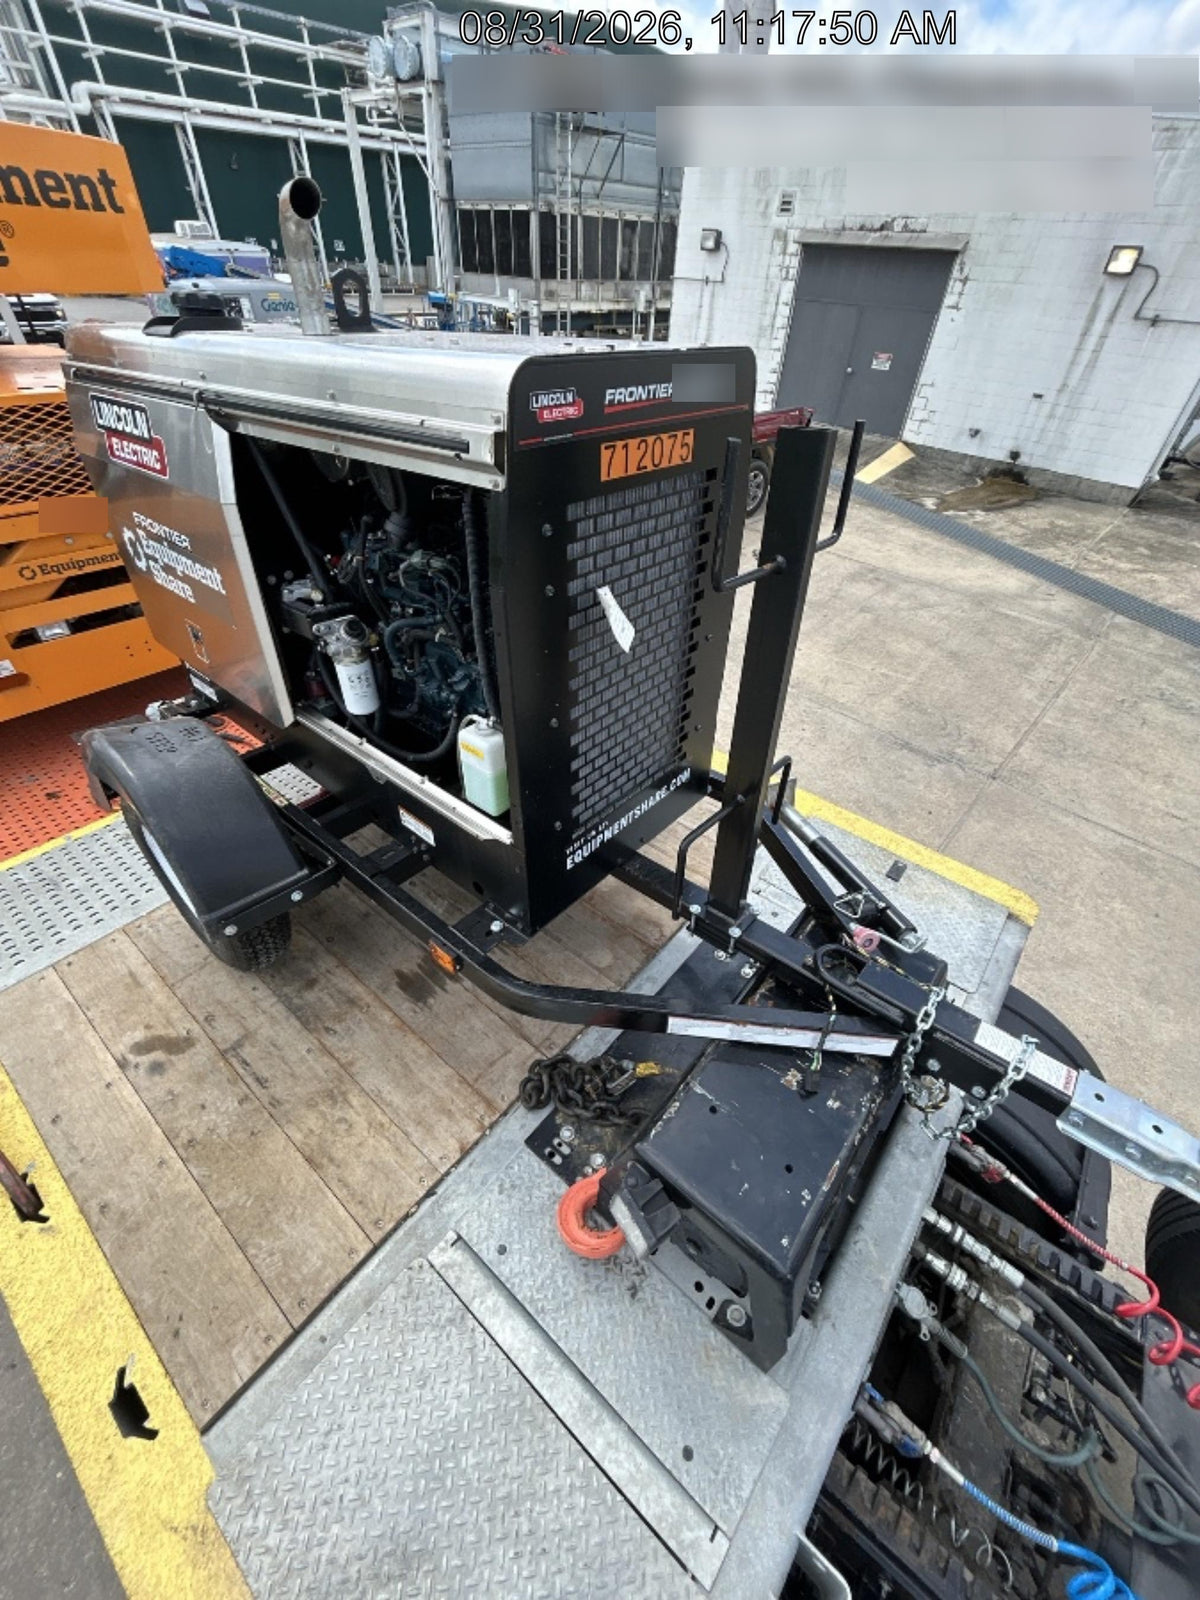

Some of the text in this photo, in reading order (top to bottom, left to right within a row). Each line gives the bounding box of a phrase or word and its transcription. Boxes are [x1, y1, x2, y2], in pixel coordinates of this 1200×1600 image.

[261, 297, 300, 312] Genie
[93, 399, 150, 440] LINCOLN
[532, 390, 574, 408] LINCOLN
[543, 406, 579, 419] ELECTRIC
[111, 436, 161, 470] ELECTRIC
[604, 431, 691, 478] 712075
[132, 511, 192, 553] FRONTIER
[136, 528, 226, 595] Equipment
[148, 559, 196, 603] Share
[566, 768, 691, 870] EQUIPMENTSHARE.COM
